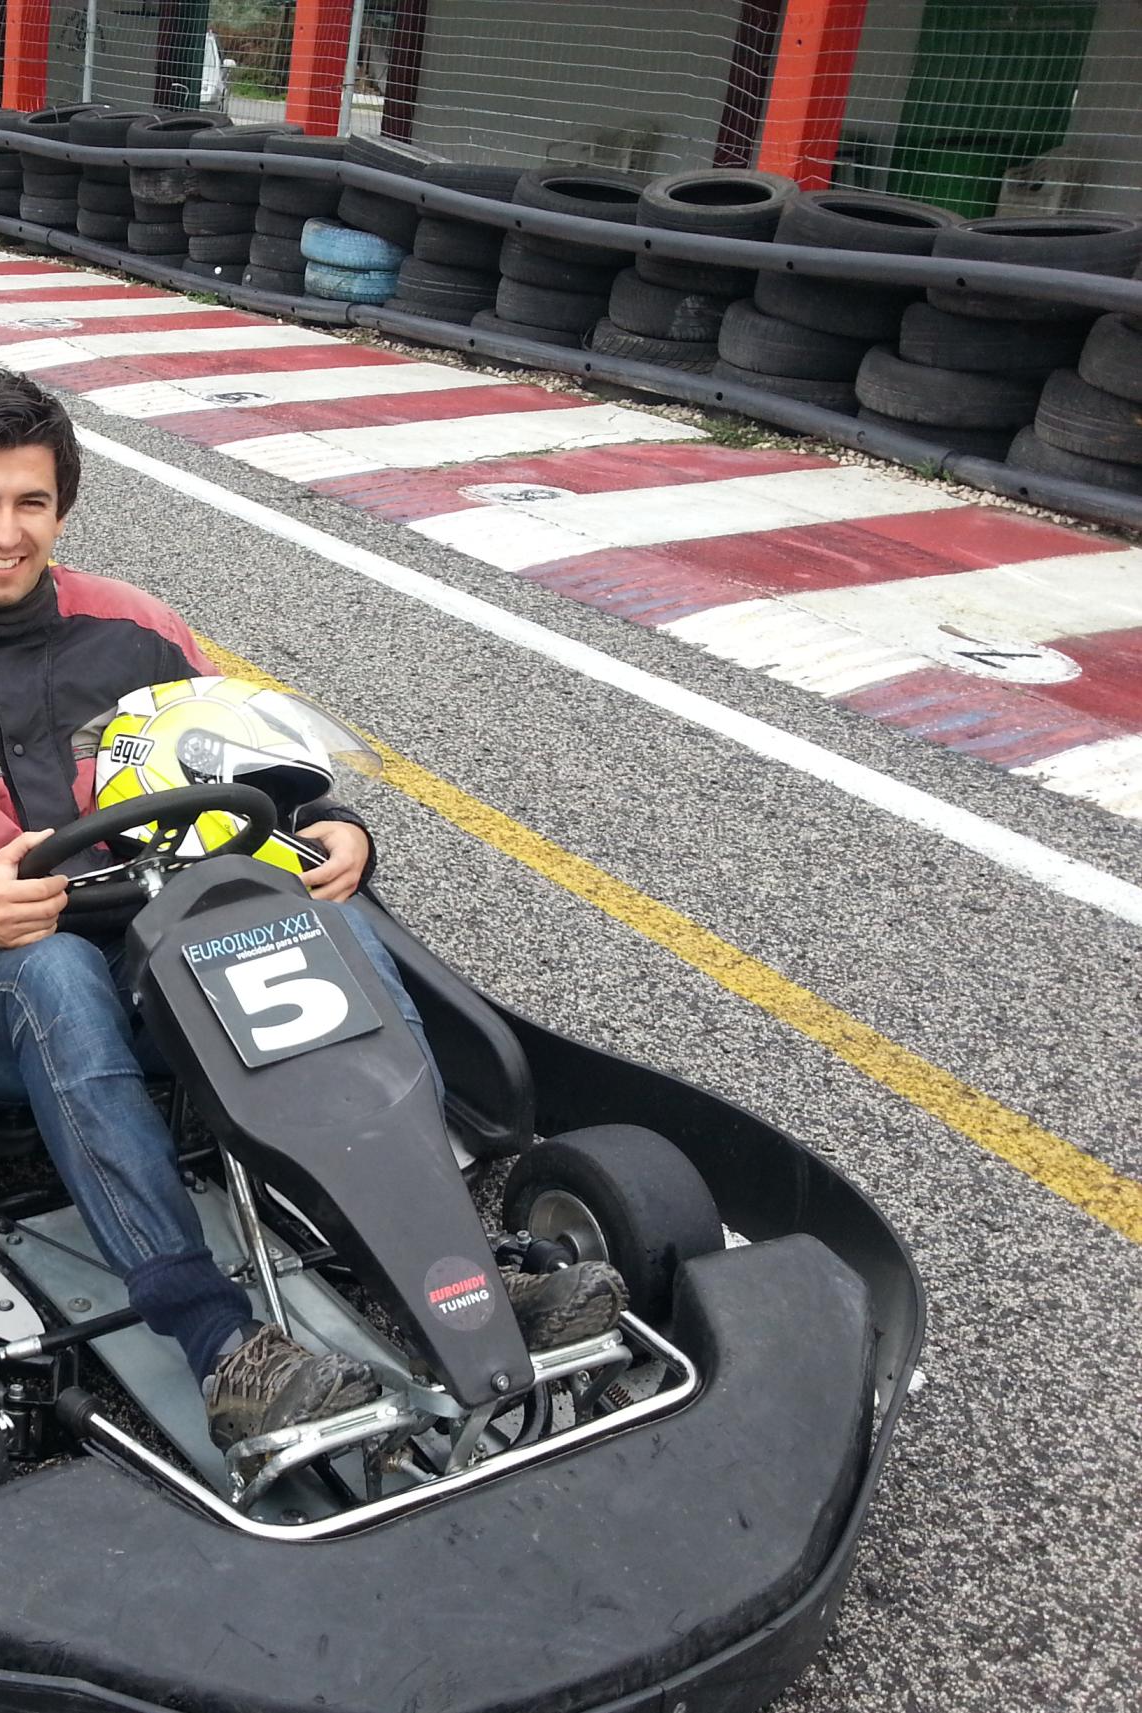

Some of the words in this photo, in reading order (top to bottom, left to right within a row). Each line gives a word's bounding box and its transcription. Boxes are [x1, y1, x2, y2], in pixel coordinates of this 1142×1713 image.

[188, 923, 275, 963] EUROINDY
[279, 912, 312, 937] XXI
[224, 946, 349, 1052] 5
[428, 1273, 487, 1303] EUROINDY
[438, 1289, 490, 1315] TUNING
